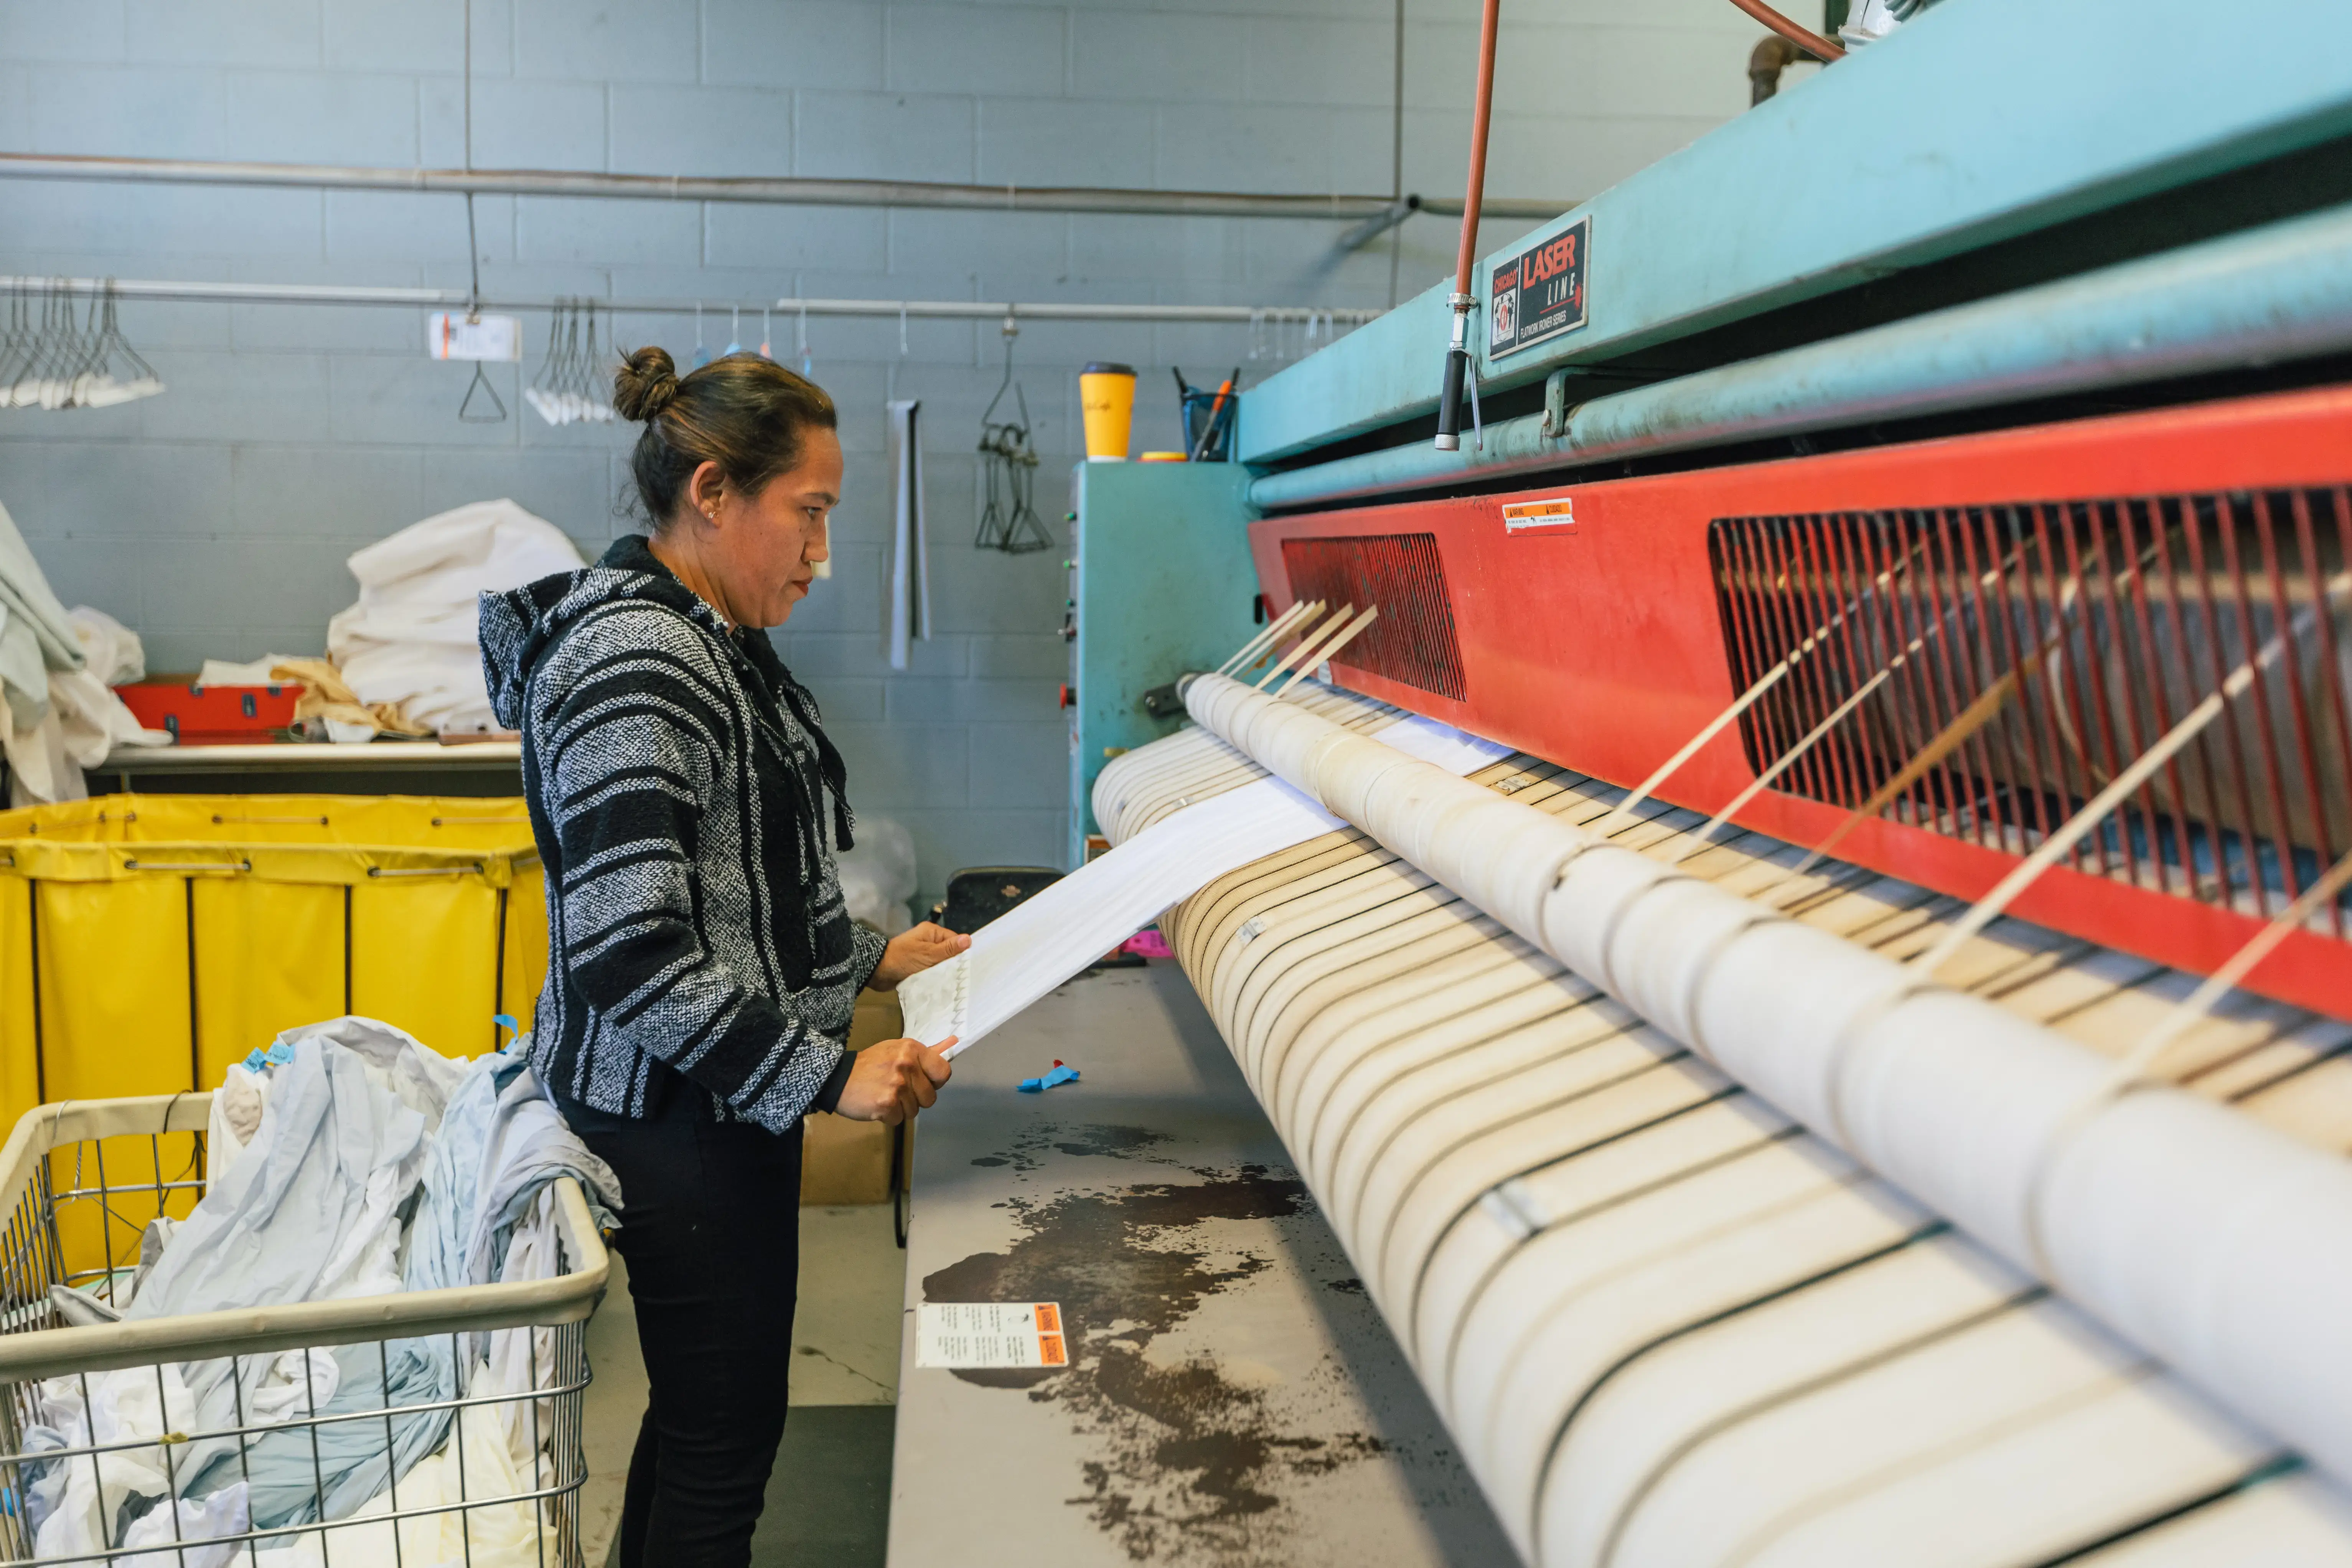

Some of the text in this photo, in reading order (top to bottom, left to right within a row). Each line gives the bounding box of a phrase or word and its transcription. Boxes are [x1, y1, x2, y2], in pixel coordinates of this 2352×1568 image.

[1523, 234, 1576, 290] LASER
[1494, 269, 1517, 294] CHICAGO
[1547, 272, 1575, 306] LINE
[1520, 310, 1566, 339] FLATWORK IRONER SERIES
